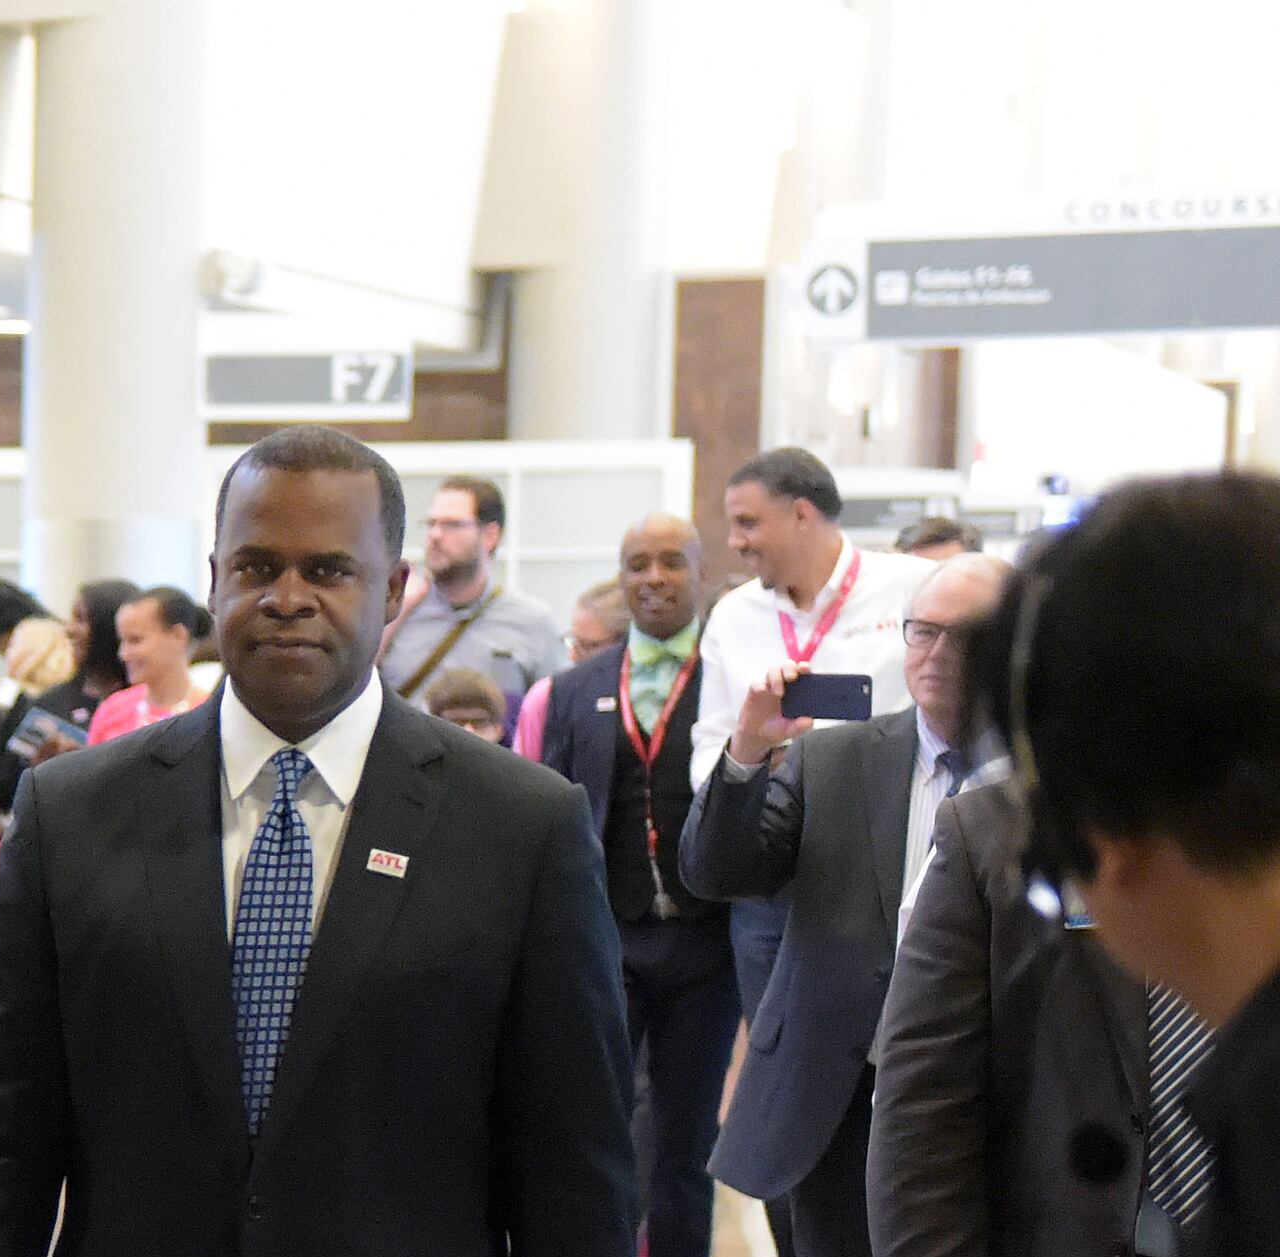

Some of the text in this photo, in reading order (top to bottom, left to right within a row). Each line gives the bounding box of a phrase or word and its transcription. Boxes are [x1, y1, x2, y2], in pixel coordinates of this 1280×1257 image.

[1063, 194, 1280, 226] CONCOURS
[331, 353, 397, 402] F7
[371, 852, 403, 870] ATL
